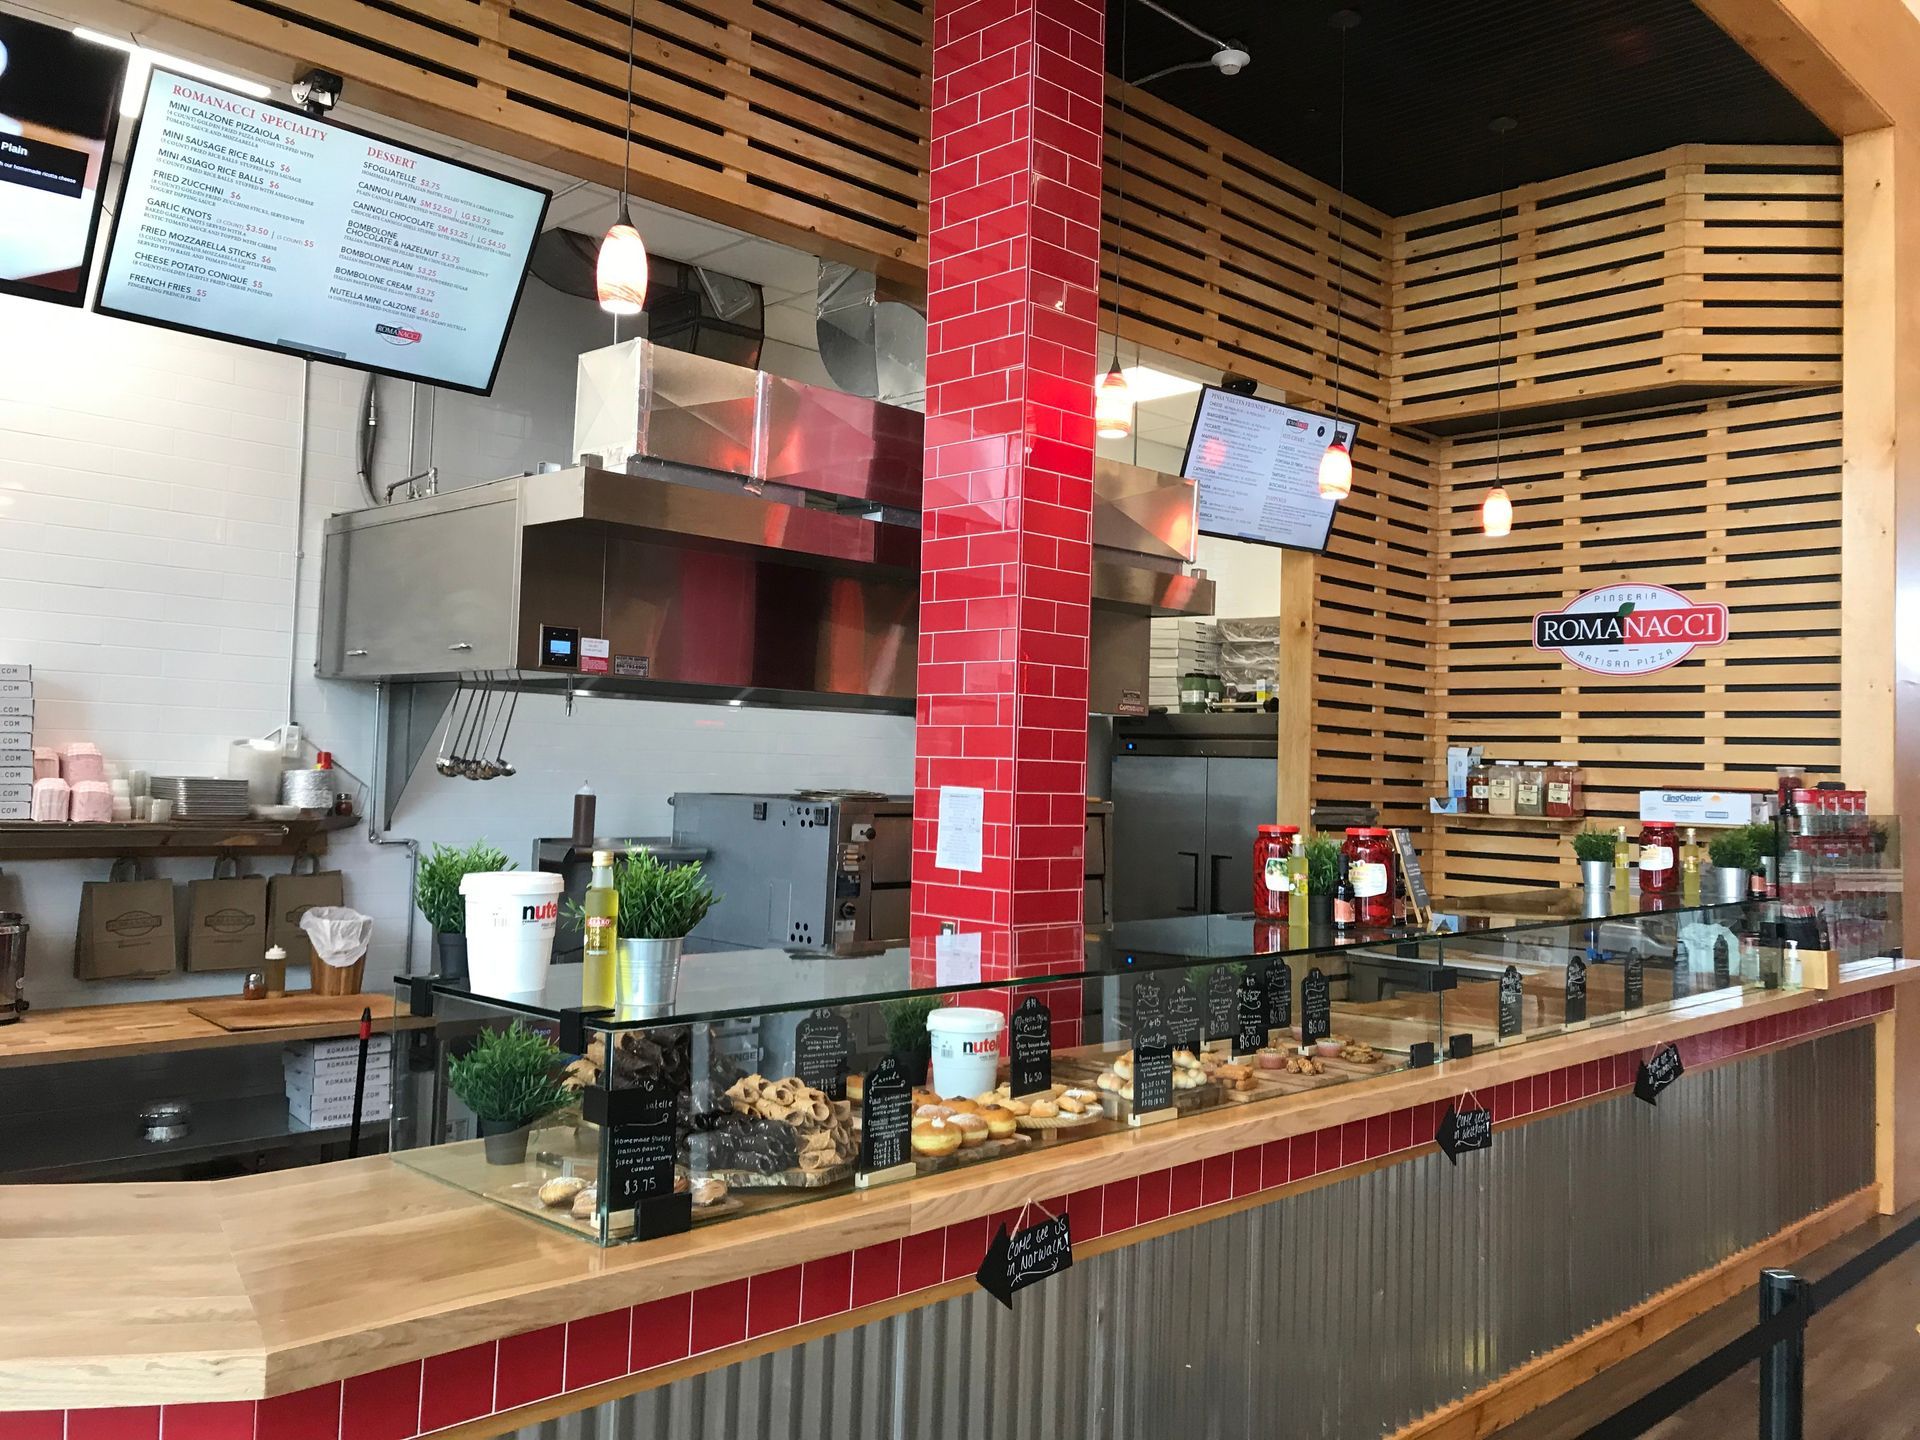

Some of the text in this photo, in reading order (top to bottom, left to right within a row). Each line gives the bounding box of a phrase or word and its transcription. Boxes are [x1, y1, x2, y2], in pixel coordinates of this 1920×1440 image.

[168, 100, 296, 146] MINI CALZONE PIZZAIOLA $6
[172, 84, 327, 141] ROMANACCI SPECIALTY
[1, 142, 28, 156] Plain
[162, 128, 291, 173] MINI SAUSAGE RICE BALLS $6
[366, 146, 417, 170] DESSERT
[157, 148, 280, 189] MINI ASIAGO RICE BALLS $6
[362, 161, 440, 191] SFOGLIATELLE $3.75
[152, 169, 241, 200] FRIED ZUCCHINI $6
[357, 180, 393, 197] CANNOLI
[394, 191, 416, 204] PLAIN
[419, 199, 432, 208] SM
[432, 202, 452, 214] $2.50
[471, 214, 490, 226] $3.75
[146, 197, 180, 212] GARLIC
[181, 206, 212, 220] KNOTS
[245, 223, 269, 236] $3.50
[303, 239, 314, 248] $5
[347, 220, 398, 239] BOMBOLONE
[352, 200, 388, 216] CANNOLI
[388, 210, 434, 229] CHOCOLATE
[436, 224, 448, 233] SM
[448, 228, 468, 239] $3.25
[487, 239, 506, 250] $4.50
[140, 224, 272, 264] FRIED MOZZARELLA STICKS $6
[345, 226, 392, 245] CHOCOLATE
[400, 241, 439, 258] HAZELNUT
[440, 252, 460, 263] $3.75
[133, 251, 263, 288] CHEESE POTATO CONIQUE $5
[340, 246, 437, 276] BOMBOLONE PLAIN $3.25
[128, 273, 207, 297] FRENCH FRIES $5
[334, 266, 385, 285] BOMBOLONE
[386, 279, 412, 291] CREAM
[415, 286, 435, 297] $3.75
[329, 286, 363, 300] NUTELLA
[363, 294, 381, 305] MINI
[381, 299, 416, 313] CALZONE
[419, 308, 440, 318] $6.50
[1594, 592, 1657, 602] PINSERIA
[1543, 614, 1716, 642] ROMANACCI
[1578, 648, 1673, 668] ARTISAN PIZZA
[624, 1177, 656, 1195] $3.75
[1007, 1218, 1066, 1260] Come see us
[1007, 1262, 1015, 1276] in
